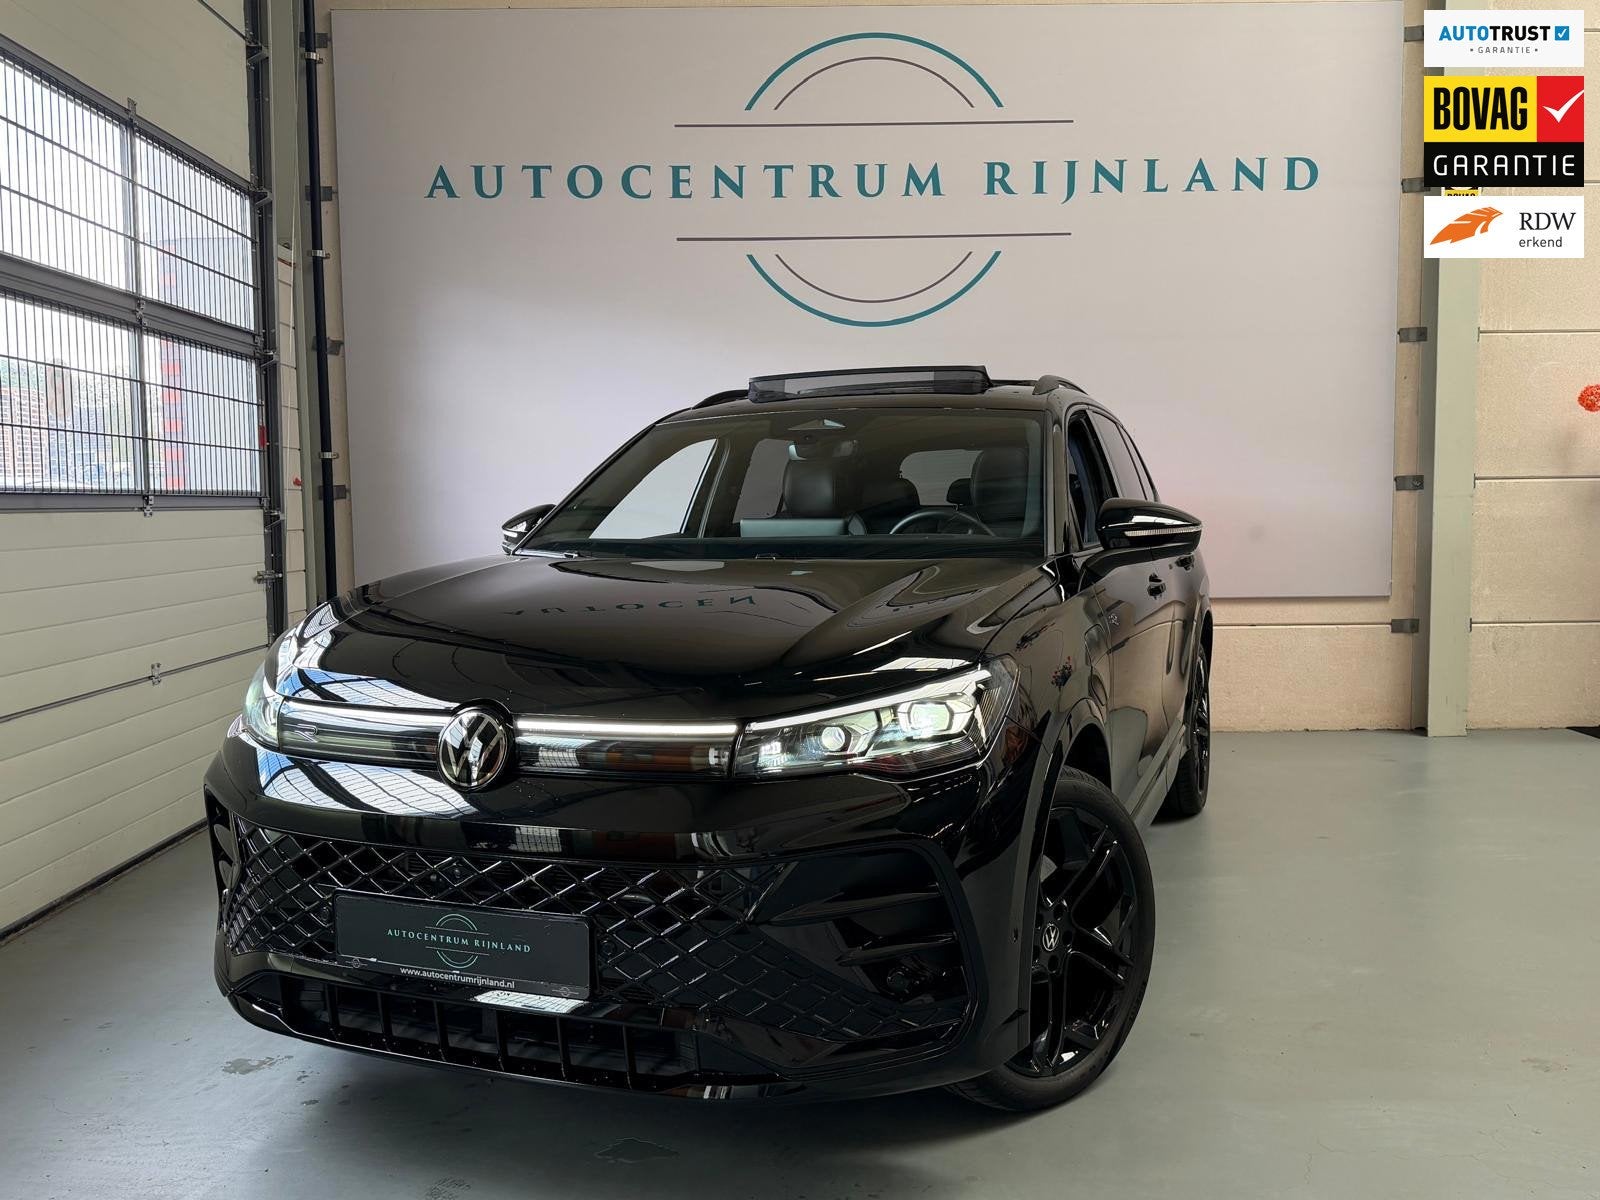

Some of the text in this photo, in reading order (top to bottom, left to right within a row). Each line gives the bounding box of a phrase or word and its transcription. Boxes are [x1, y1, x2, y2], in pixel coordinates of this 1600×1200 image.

[425, 156, 1321, 204] AUTOCENTRUM RIJNLAND
[386, 928, 532, 954] AUTOCENTRUM RIJNLAND
[399, 966, 516, 990] www.autocentrumrijnland.nl
